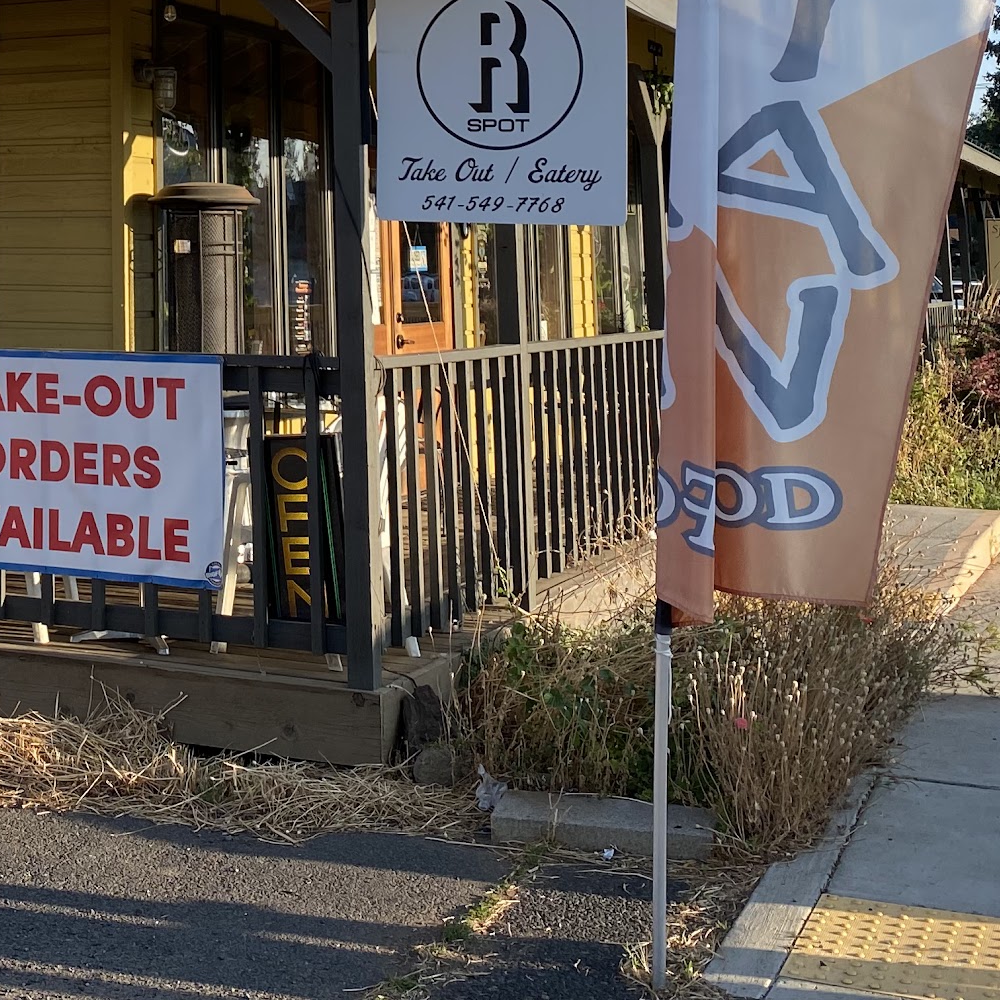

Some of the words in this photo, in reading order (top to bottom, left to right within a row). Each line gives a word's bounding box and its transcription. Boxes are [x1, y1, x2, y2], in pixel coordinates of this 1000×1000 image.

[466, 118, 530, 133] SPOT
[398, 156, 447, 182] Take
[454, 157, 495, 182] Out
[527, 157, 603, 192] Eatery
[421, 195, 566, 213] 541-549-7768
